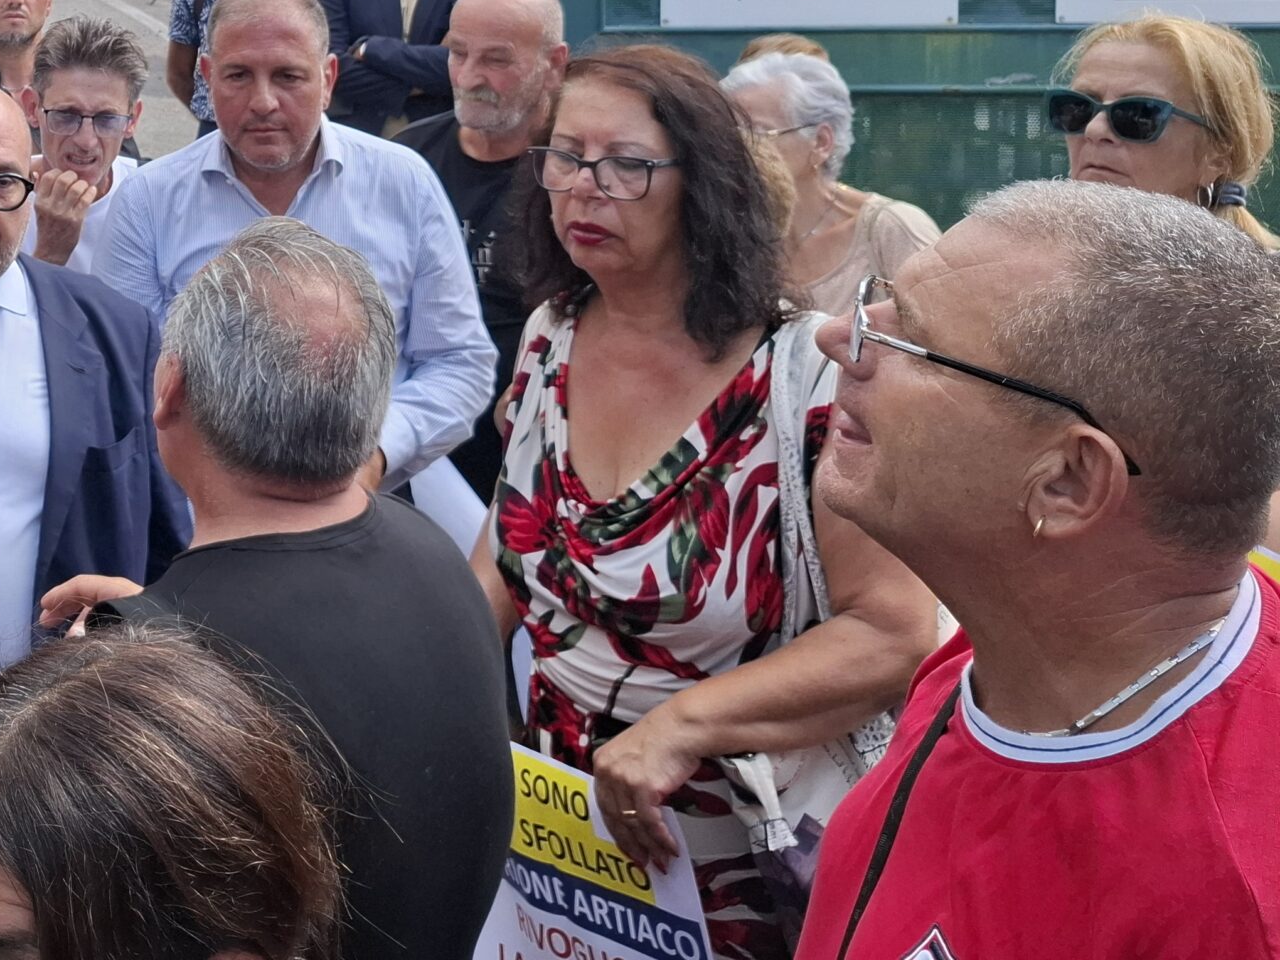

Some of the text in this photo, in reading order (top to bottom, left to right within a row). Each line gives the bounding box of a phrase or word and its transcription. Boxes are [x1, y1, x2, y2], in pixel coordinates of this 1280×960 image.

[520, 768, 589, 821] SONO
[519, 818, 651, 891] SFOLLATO
[573, 889, 700, 960] ARTIACO
